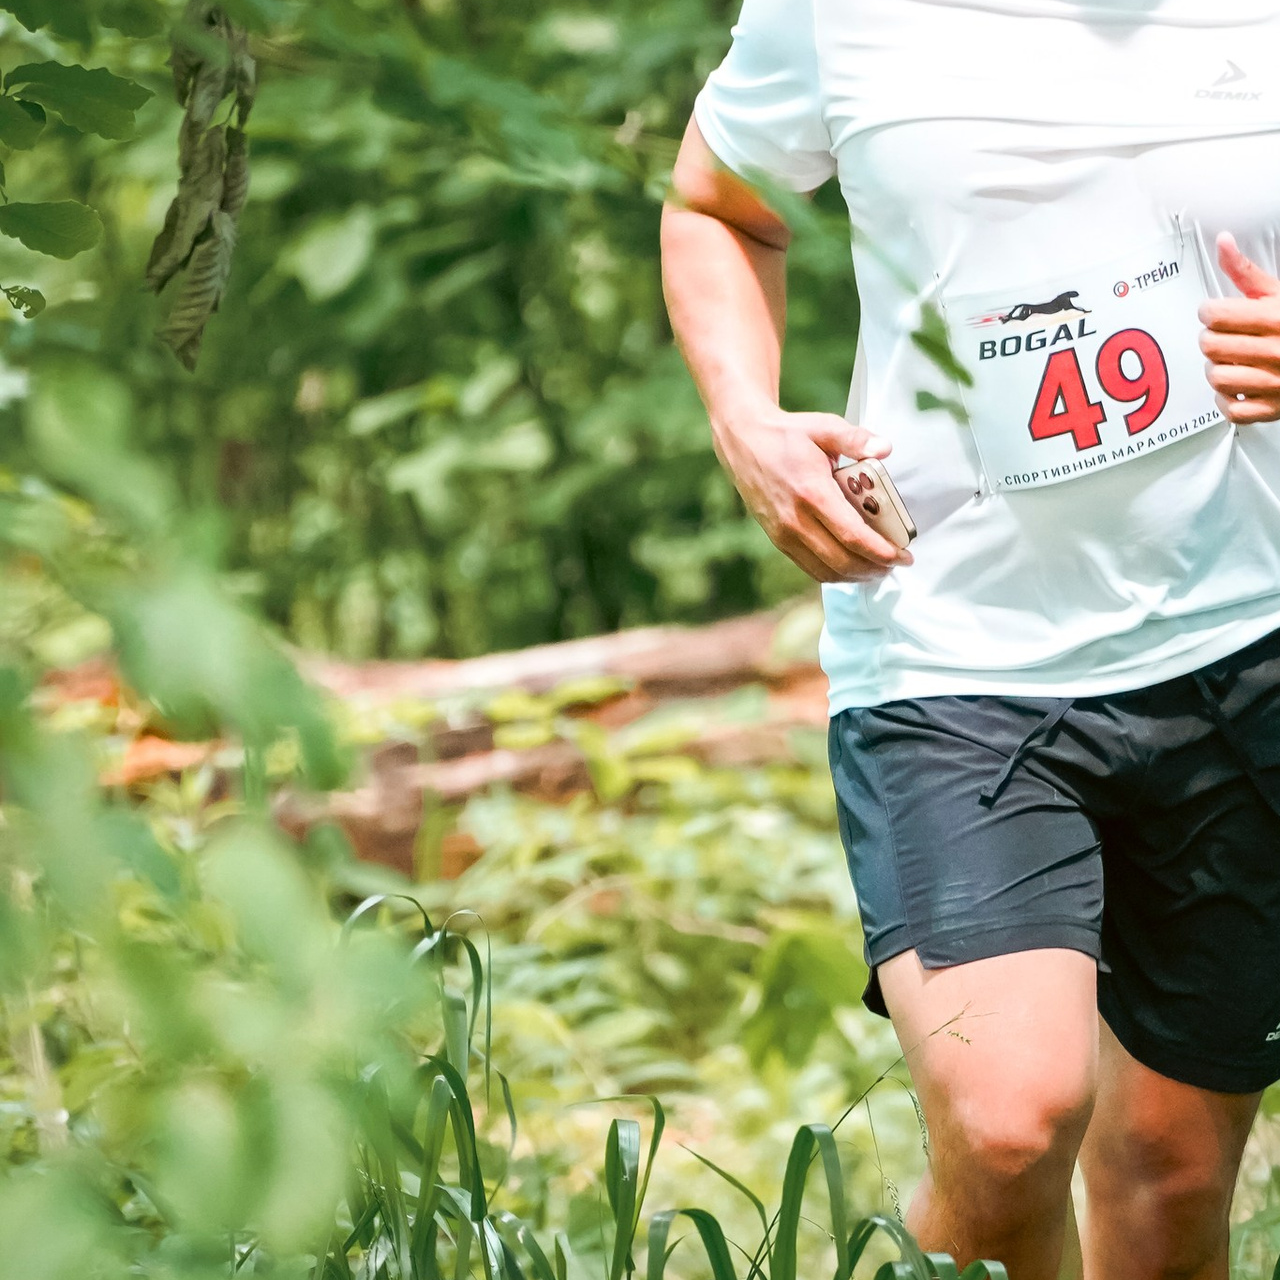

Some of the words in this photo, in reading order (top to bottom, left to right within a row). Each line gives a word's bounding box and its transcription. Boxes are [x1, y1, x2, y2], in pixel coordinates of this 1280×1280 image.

[1194, 89, 1263, 101] DEMIX
[978, 318, 1097, 361] BOGAL
[1027, 327, 1170, 452] 49
[1004, 453, 1107, 486] СПОРТИВНЫЙ
[1112, 422, 1189, 460] МАРАФОН
[1191, 410, 1219, 429] 2026
